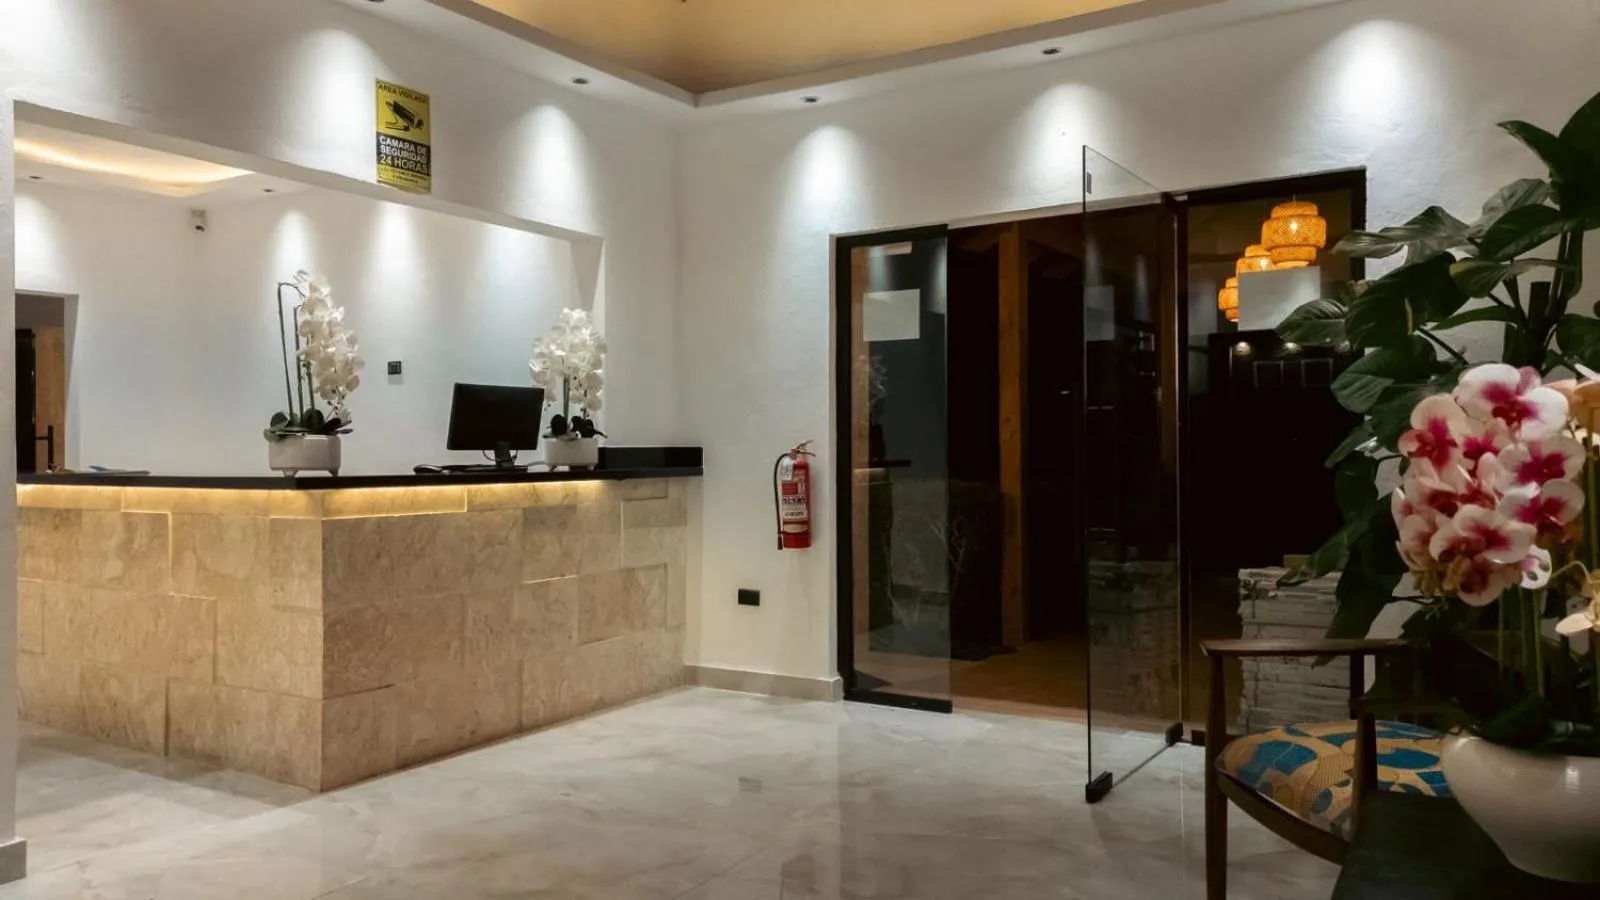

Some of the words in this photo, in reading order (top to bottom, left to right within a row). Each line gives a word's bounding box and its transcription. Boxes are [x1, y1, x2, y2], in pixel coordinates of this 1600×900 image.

[378, 83, 397, 95] AREA
[380, 135, 415, 152] CAMARA
[416, 145, 428, 155] DE
[380, 144, 428, 163] SEGURIDAD
[380, 154, 392, 165] 24
[394, 157, 429, 174] HORAS
